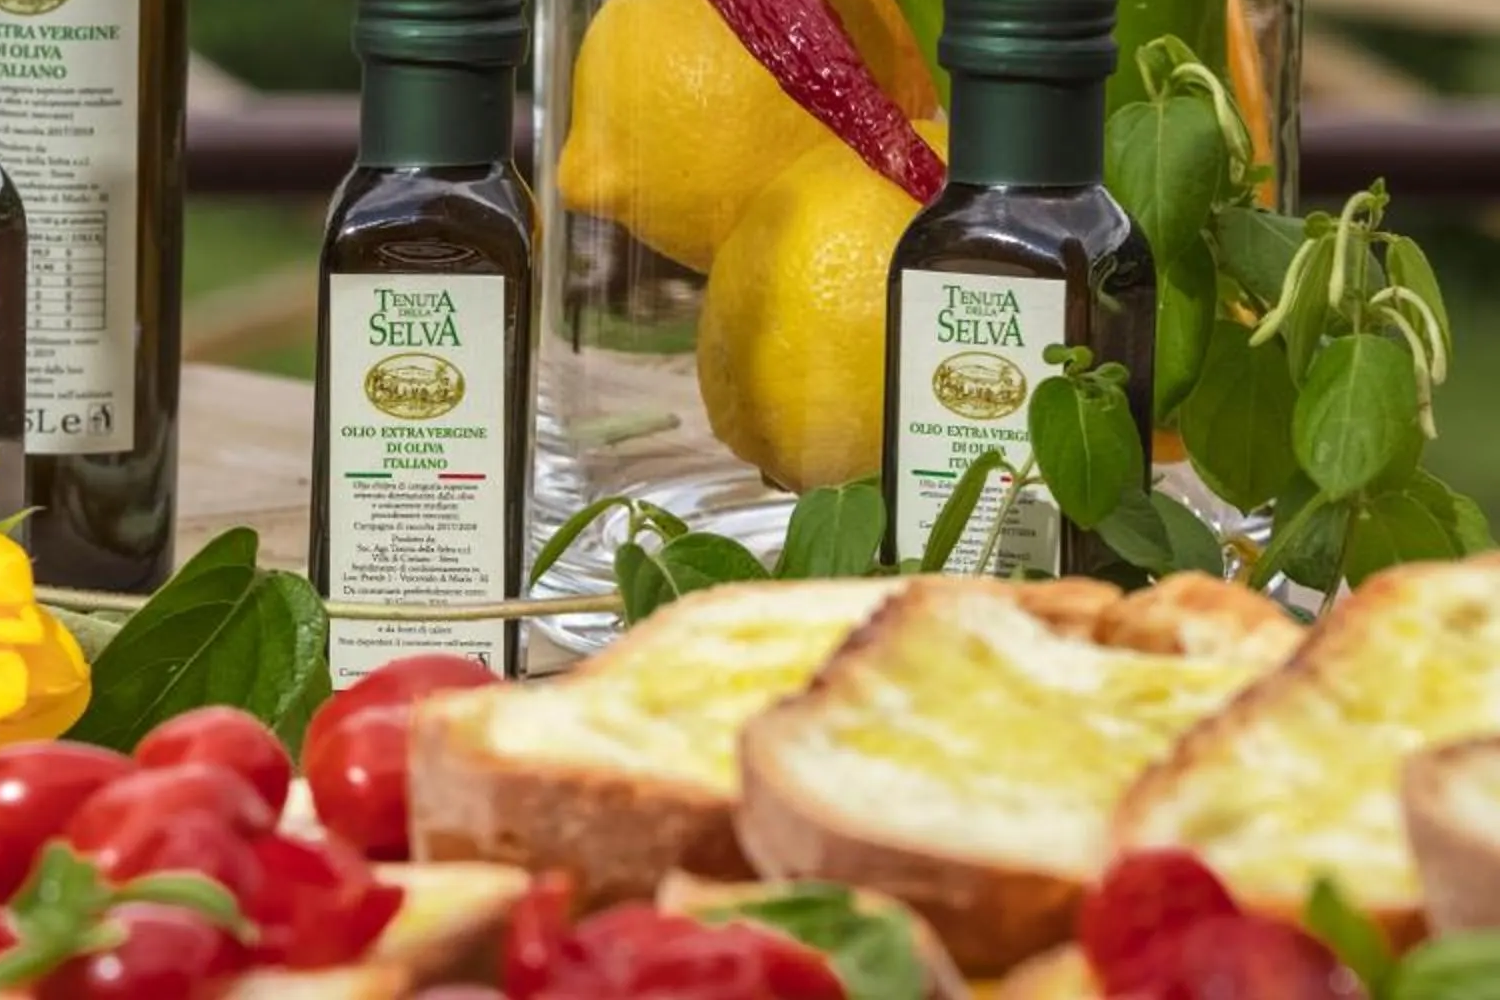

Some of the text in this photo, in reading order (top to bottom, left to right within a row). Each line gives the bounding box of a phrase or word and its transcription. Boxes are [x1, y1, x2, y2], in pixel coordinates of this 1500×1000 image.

[38, 25, 120, 40] VERGINE
[10, 43, 62, 60] OLIVA
[374, 289, 457, 313] TENUTA
[943, 285, 1020, 313] TENUTA
[370, 313, 461, 346] SELVA
[937, 310, 1024, 346] SELVA
[61, 412, 82, 434] e
[910, 422, 942, 434] OLIO
[947, 425, 990, 438] EXTRA
[341, 426, 487, 439] OLIO EXTRA VERGINE
[386, 443, 444, 454] DI OLIVA
[952, 442, 966, 453] DI
[383, 458, 448, 469] ITALIANO
